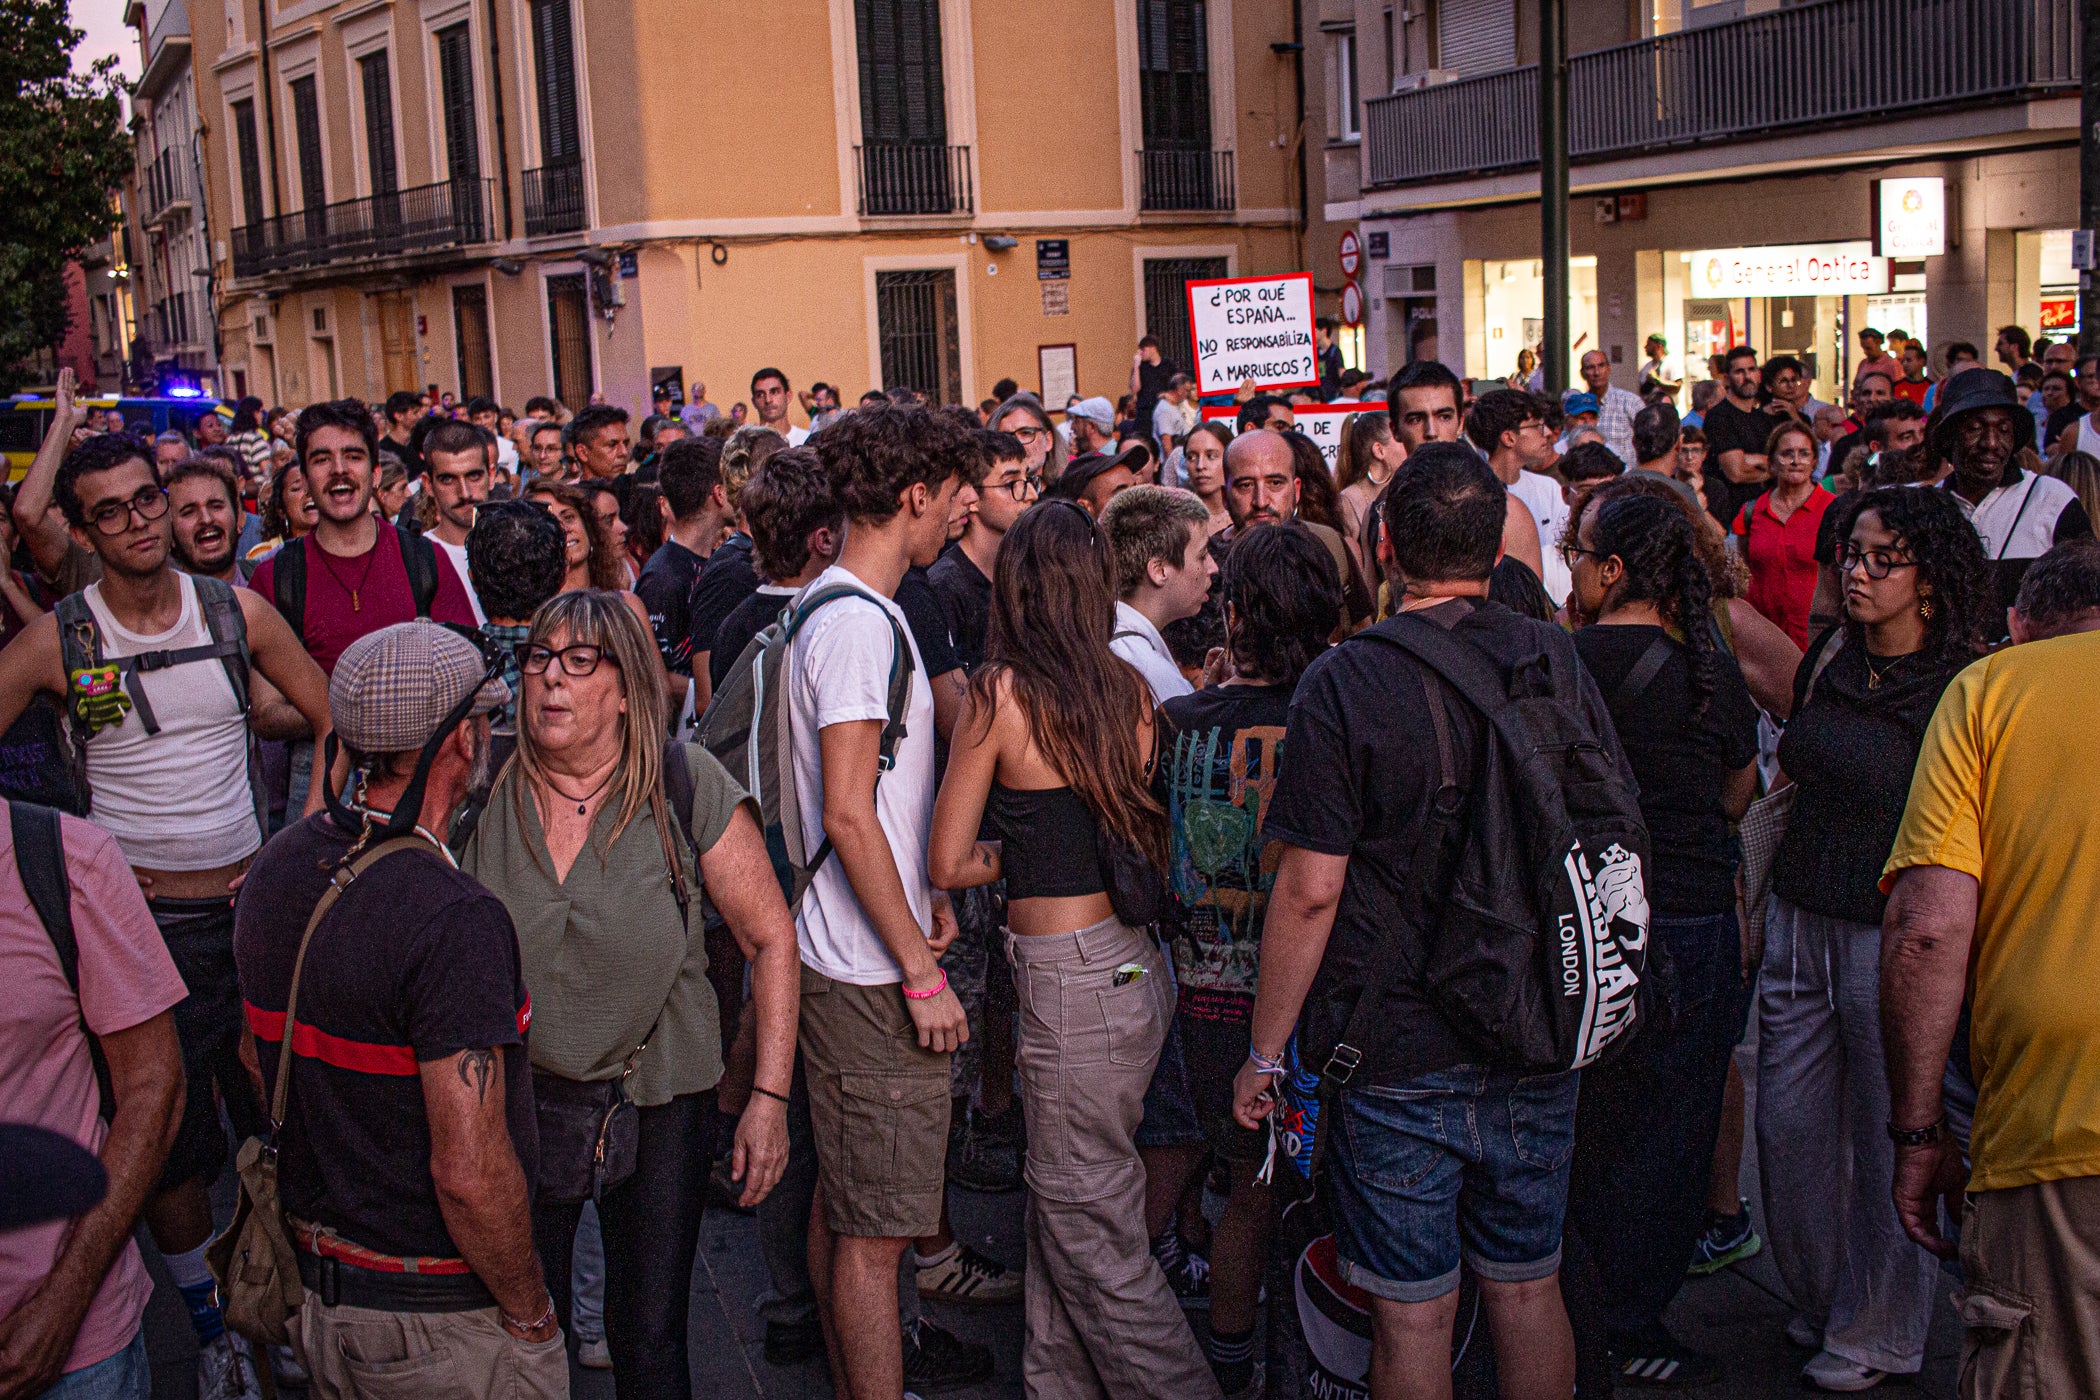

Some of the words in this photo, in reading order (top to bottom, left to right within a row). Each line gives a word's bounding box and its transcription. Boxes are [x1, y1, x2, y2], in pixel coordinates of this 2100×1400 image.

[1807, 255, 1869, 287] Optica
[1258, 283, 1286, 302] QUÉ
[1227, 305, 1296, 324] ESPAÑA...
[1199, 339, 1218, 355] NO
[1212, 369, 1223, 382] A
[1314, 421, 1331, 435] DE
[1558, 913, 1581, 997] LONDON
